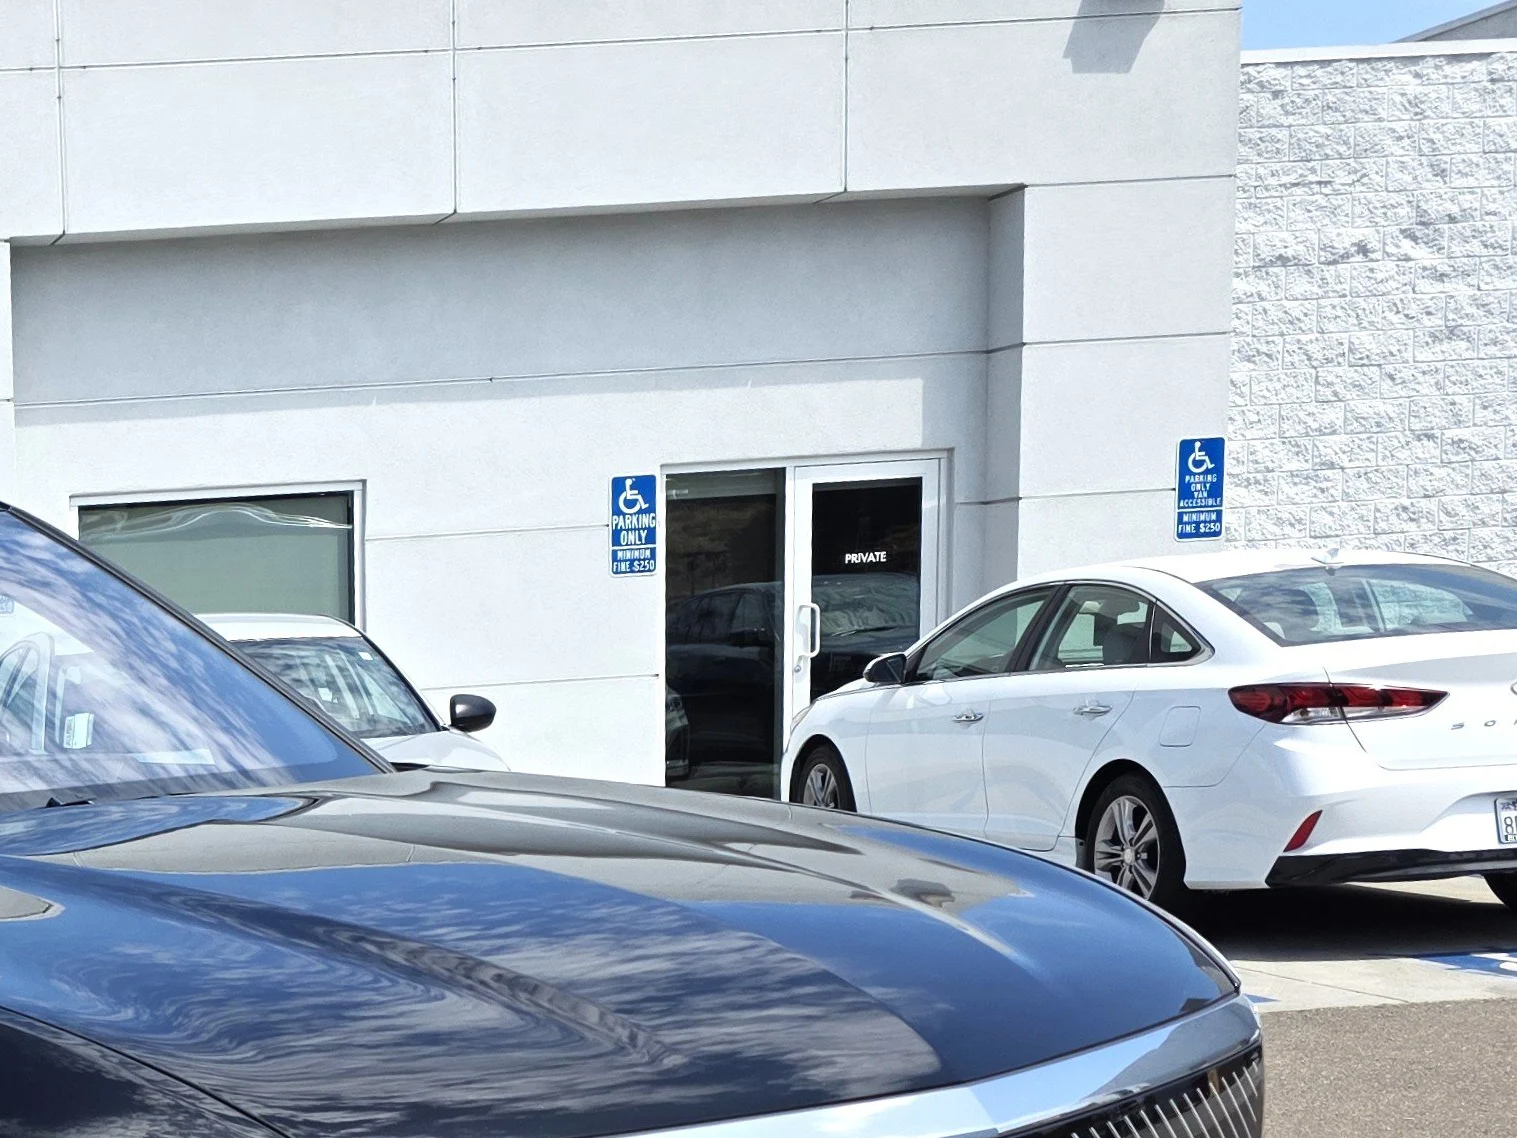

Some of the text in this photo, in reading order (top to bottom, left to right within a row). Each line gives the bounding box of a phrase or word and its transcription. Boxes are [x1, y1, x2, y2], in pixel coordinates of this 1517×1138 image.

[1185, 474, 1217, 484] PARKING
[1191, 483, 1210, 492] ONLY
[1194, 491, 1207, 499] VAN
[1179, 498, 1221, 507] ACCESSIBLE
[612, 513, 656, 529] PARKING
[1182, 512, 1216, 522] MINIMUM
[1178, 522, 1220, 533] FINE $250
[620, 530, 647, 546] ONLY
[617, 549, 651, 560] MINIMUM
[845, 551, 887, 564] PRIVATE
[613, 560, 655, 572] FINE $250
